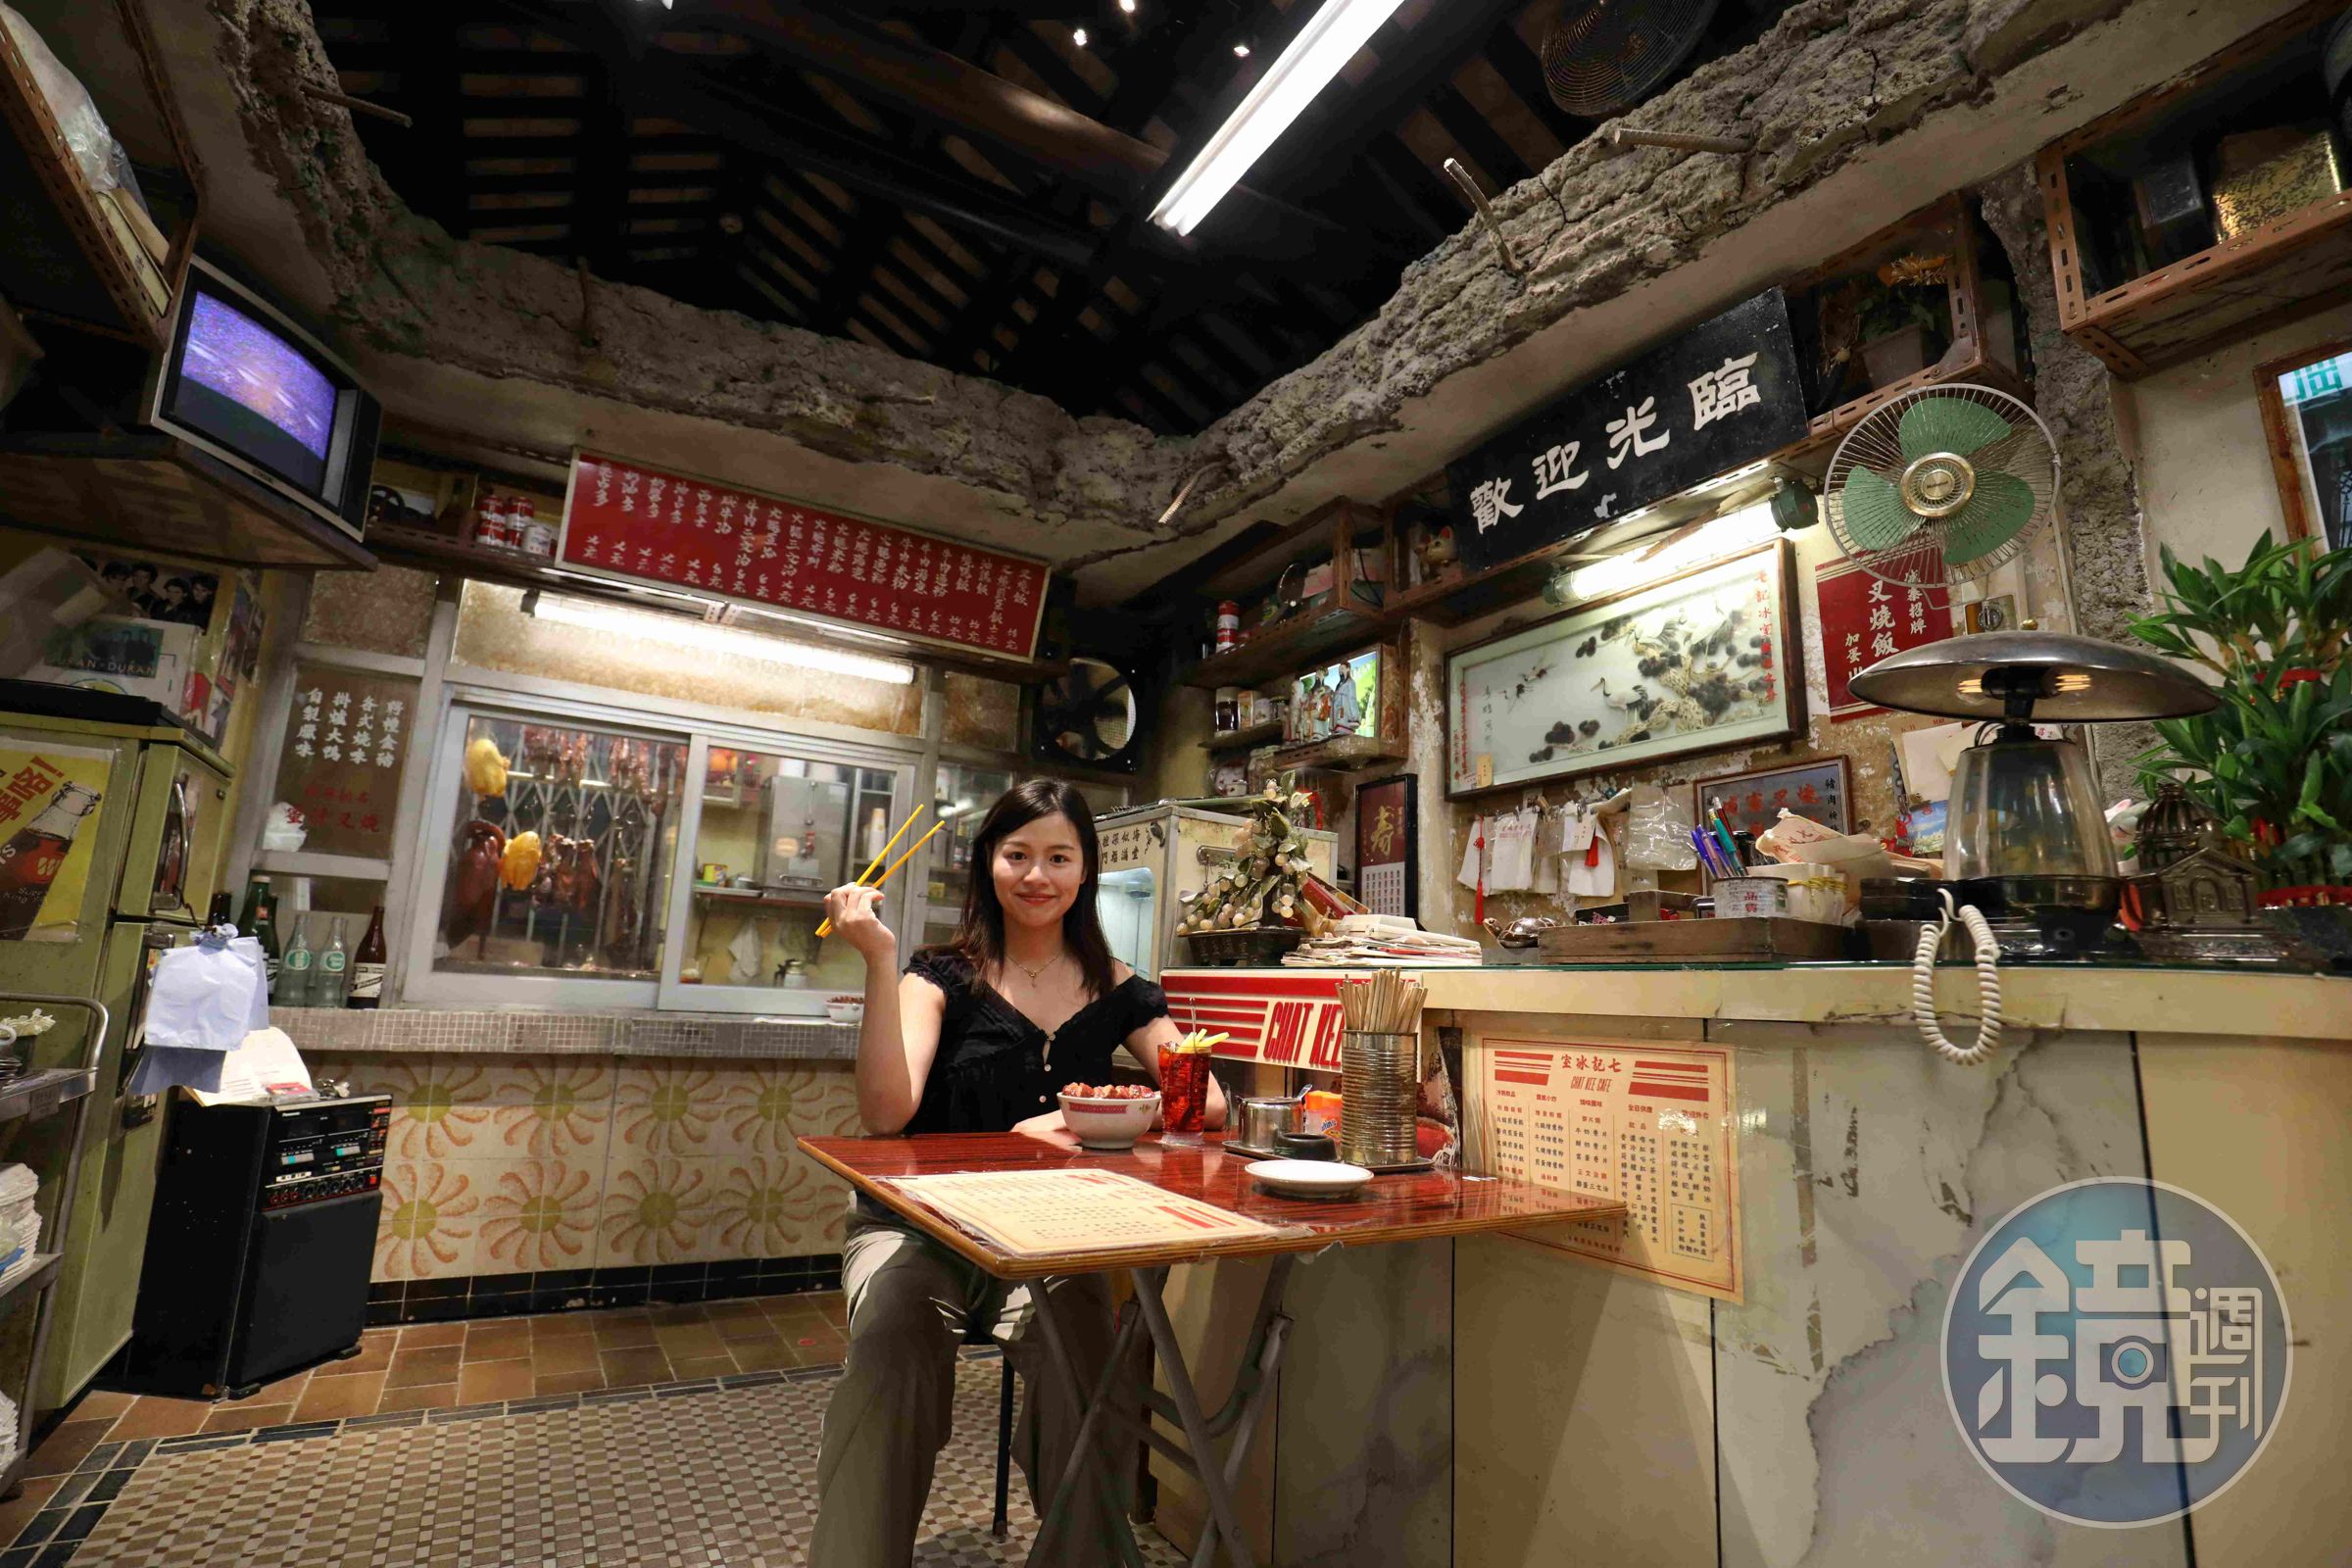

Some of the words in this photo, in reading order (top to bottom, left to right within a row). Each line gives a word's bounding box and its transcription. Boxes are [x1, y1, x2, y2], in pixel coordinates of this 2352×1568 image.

[1470, 351, 1762, 534] 歡迎光臨
[1867, 580, 1900, 658] 叉燒飯
[1263, 1001, 1314, 1063] CHAT
